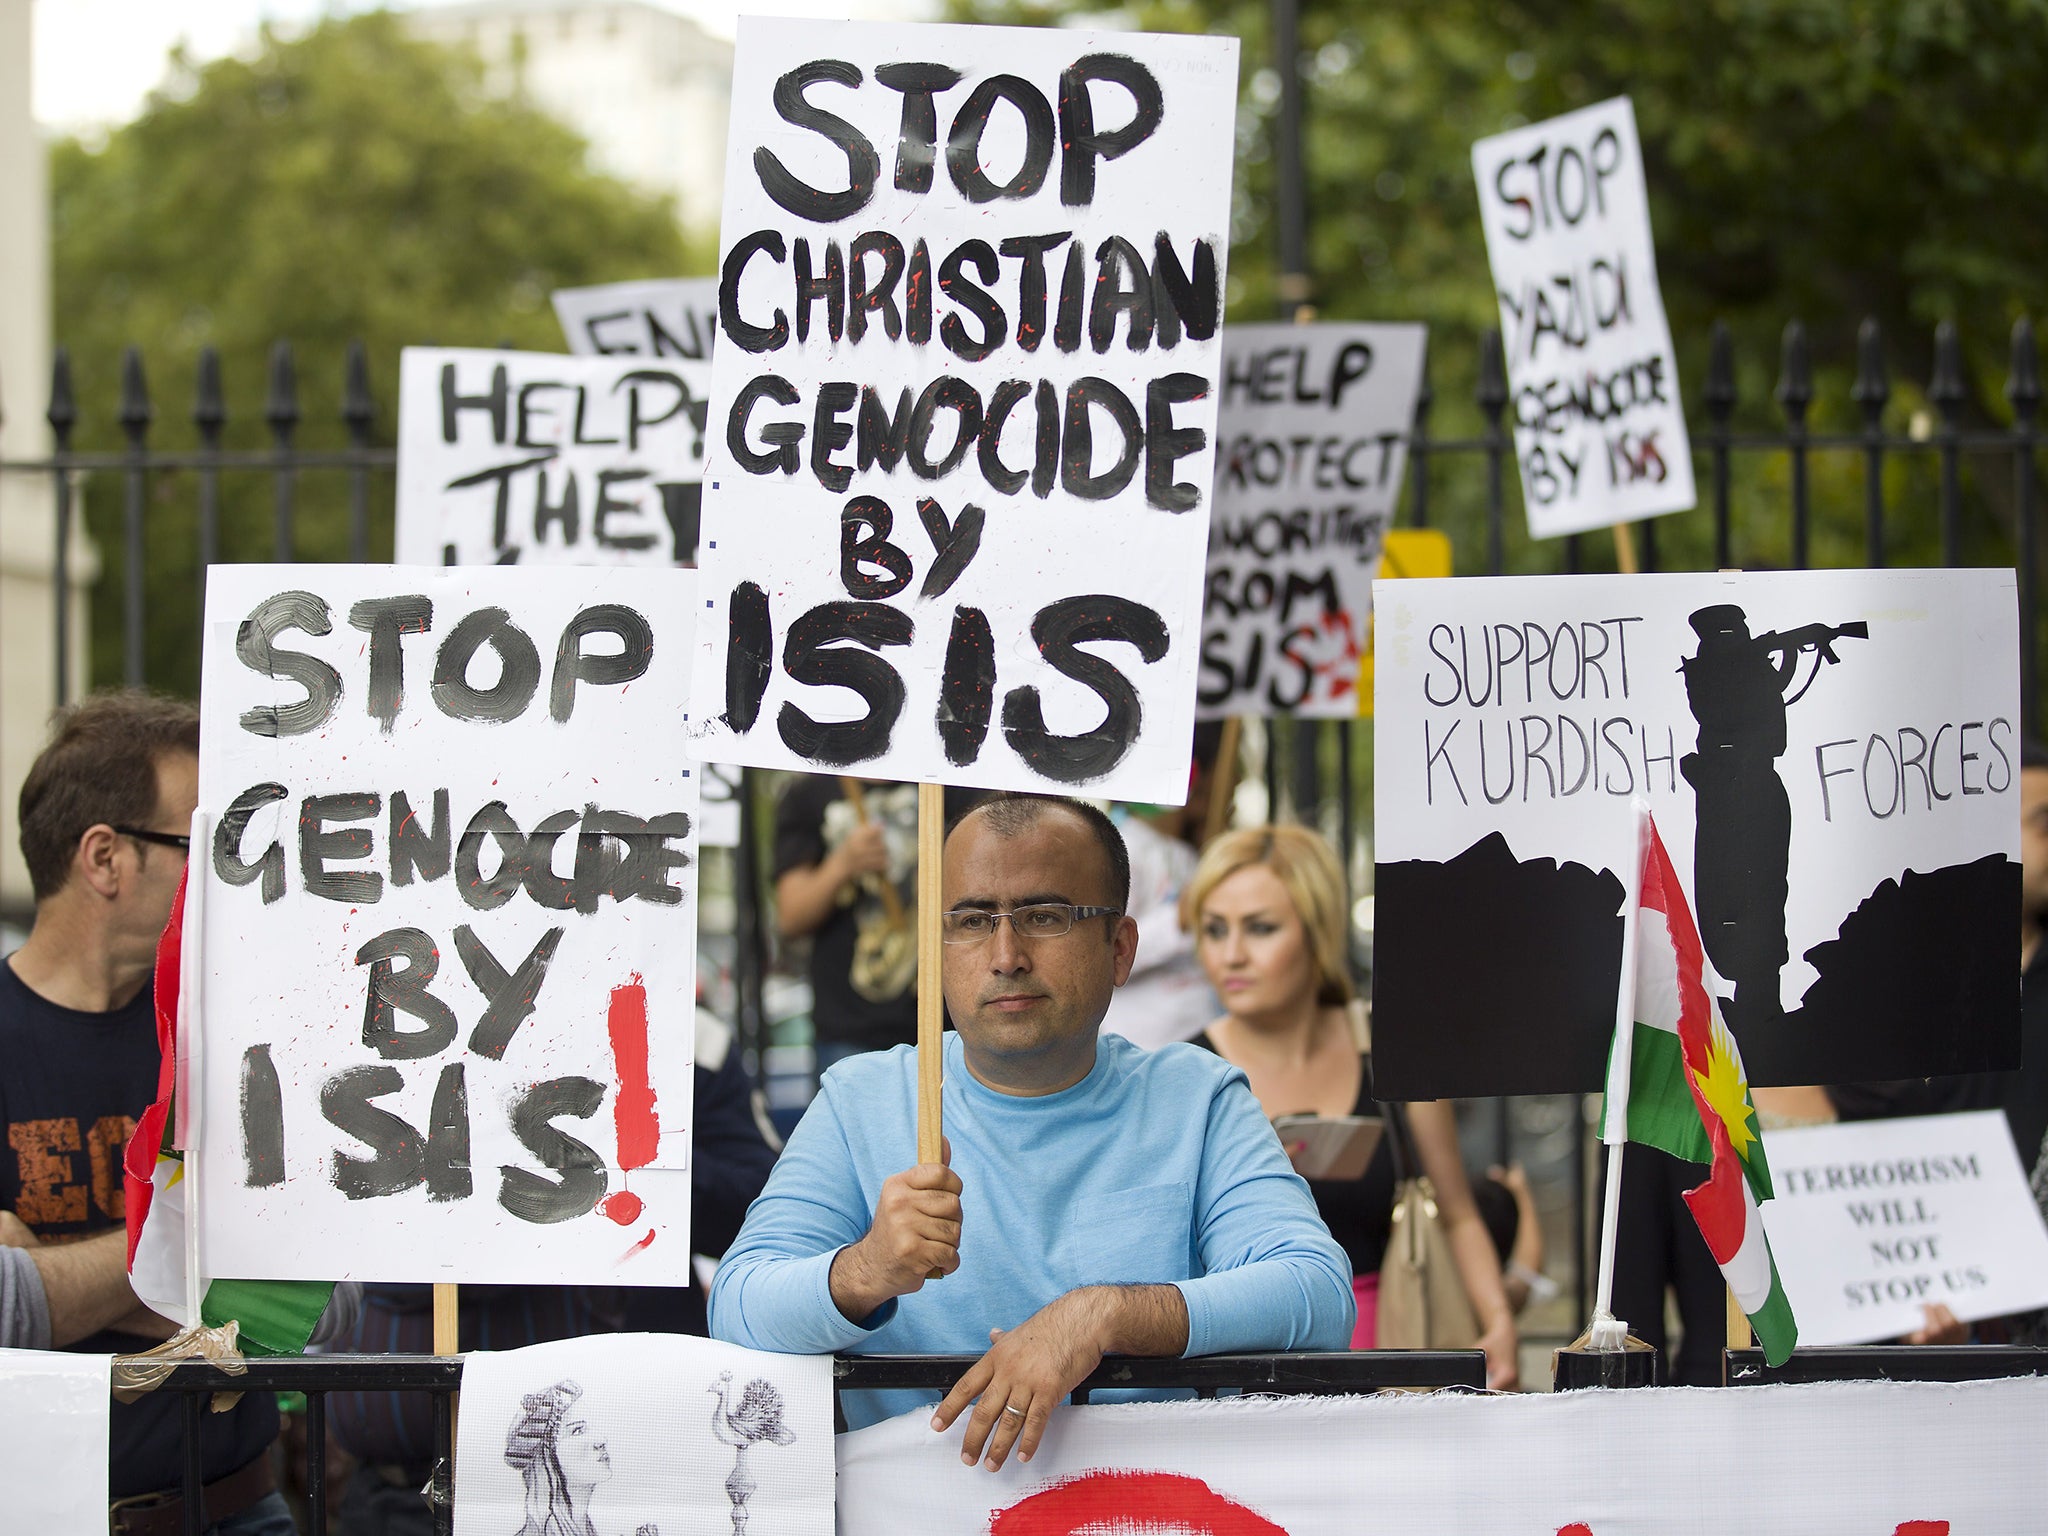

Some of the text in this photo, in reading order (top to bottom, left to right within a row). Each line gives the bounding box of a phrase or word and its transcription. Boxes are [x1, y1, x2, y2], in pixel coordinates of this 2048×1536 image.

[754, 52, 1164, 222] STOP
[1496, 127, 1621, 240] STOP
[586, 307, 716, 360] EN
[719, 229, 1221, 362] CHRISTIAN
[1225, 341, 1373, 409] HELP
[727, 373, 1209, 514] GENOCIDE
[1217, 431, 1400, 492] ROTECT
[1526, 429, 1668, 504] BY ISIS
[446, 449, 660, 550] THE
[840, 495, 985, 600] BY
[1205, 567, 1340, 622] ROM
[236, 589, 654, 738] STOP
[725, 580, 1170, 785] ISIS
[1198, 626, 1318, 709] SIS
[1424, 616, 1643, 707] SUPPORT
[1425, 714, 2012, 821] KURDISH FORCES
[213, 781, 693, 915] GENOCIDE
[355, 924, 566, 1060] BY
[241, 972, 660, 1226] ISIS!
[1780, 1153, 1981, 1195] TERRORISM
[1846, 1197, 1938, 1228] WILL
[1844, 1266, 1988, 1307] STOP US
[1870, 1235, 1941, 1267] NOT
